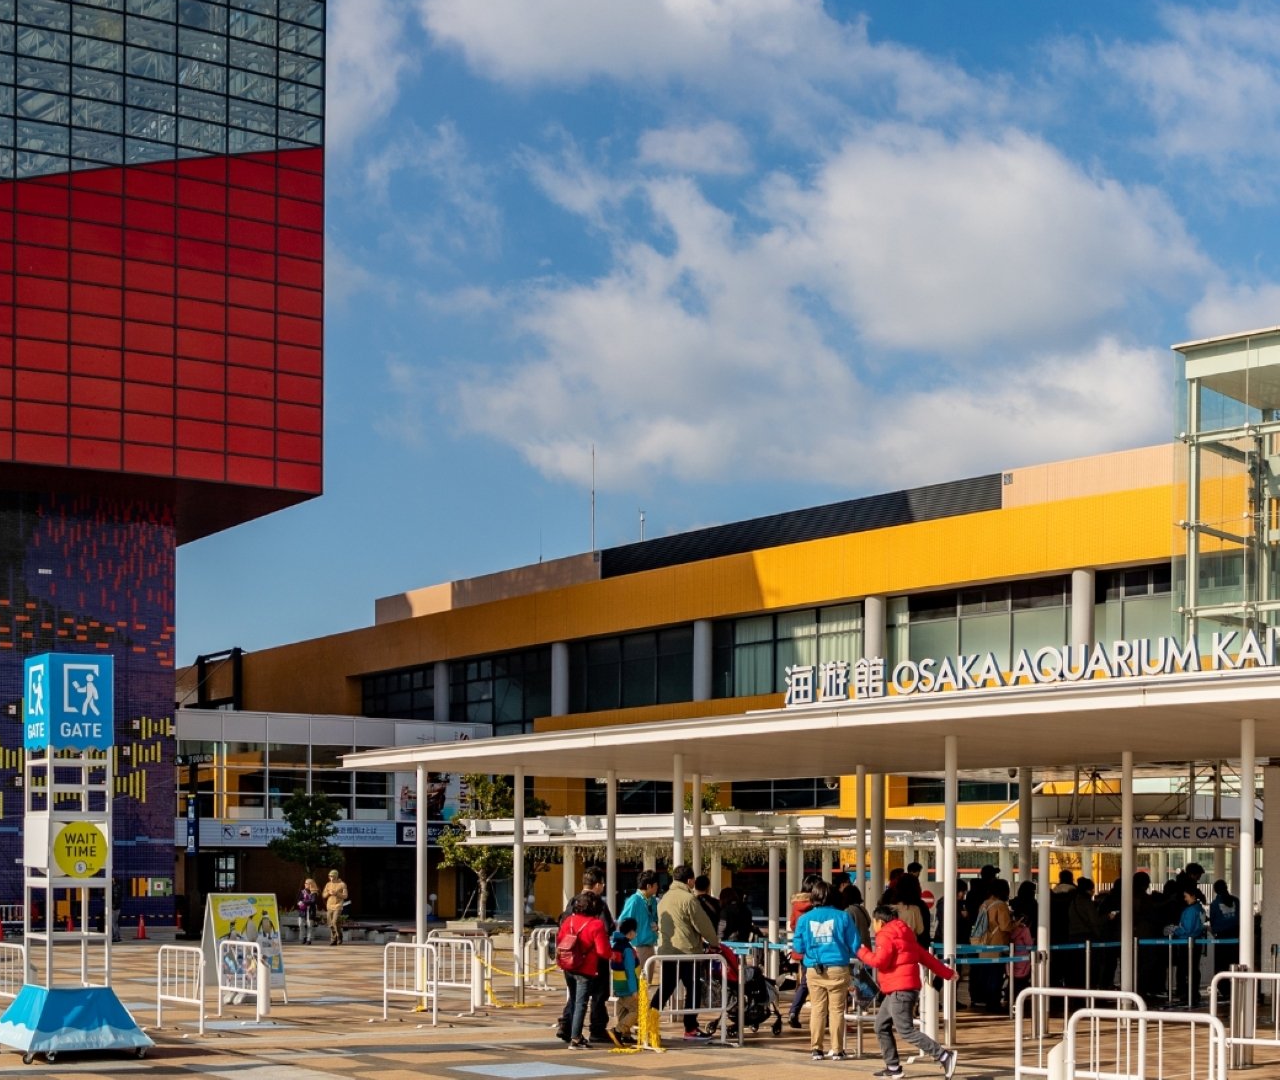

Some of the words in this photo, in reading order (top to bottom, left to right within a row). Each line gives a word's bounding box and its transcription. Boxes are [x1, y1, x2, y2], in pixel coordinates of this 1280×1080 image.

[892, 651, 1005, 695] OSAKA
[1009, 633, 1200, 685] AQUARIUM
[1212, 627, 1280, 670] KAI
[784, 655, 887, 704] 海遊館
[28, 722, 45, 739] GATE
[60, 722, 102, 738] GATE
[64, 832, 97, 845] WAIT
[1118, 826, 1190, 840] ETRANCE
[1196, 826, 1235, 840] GATE
[65, 846, 97, 857] TIME
